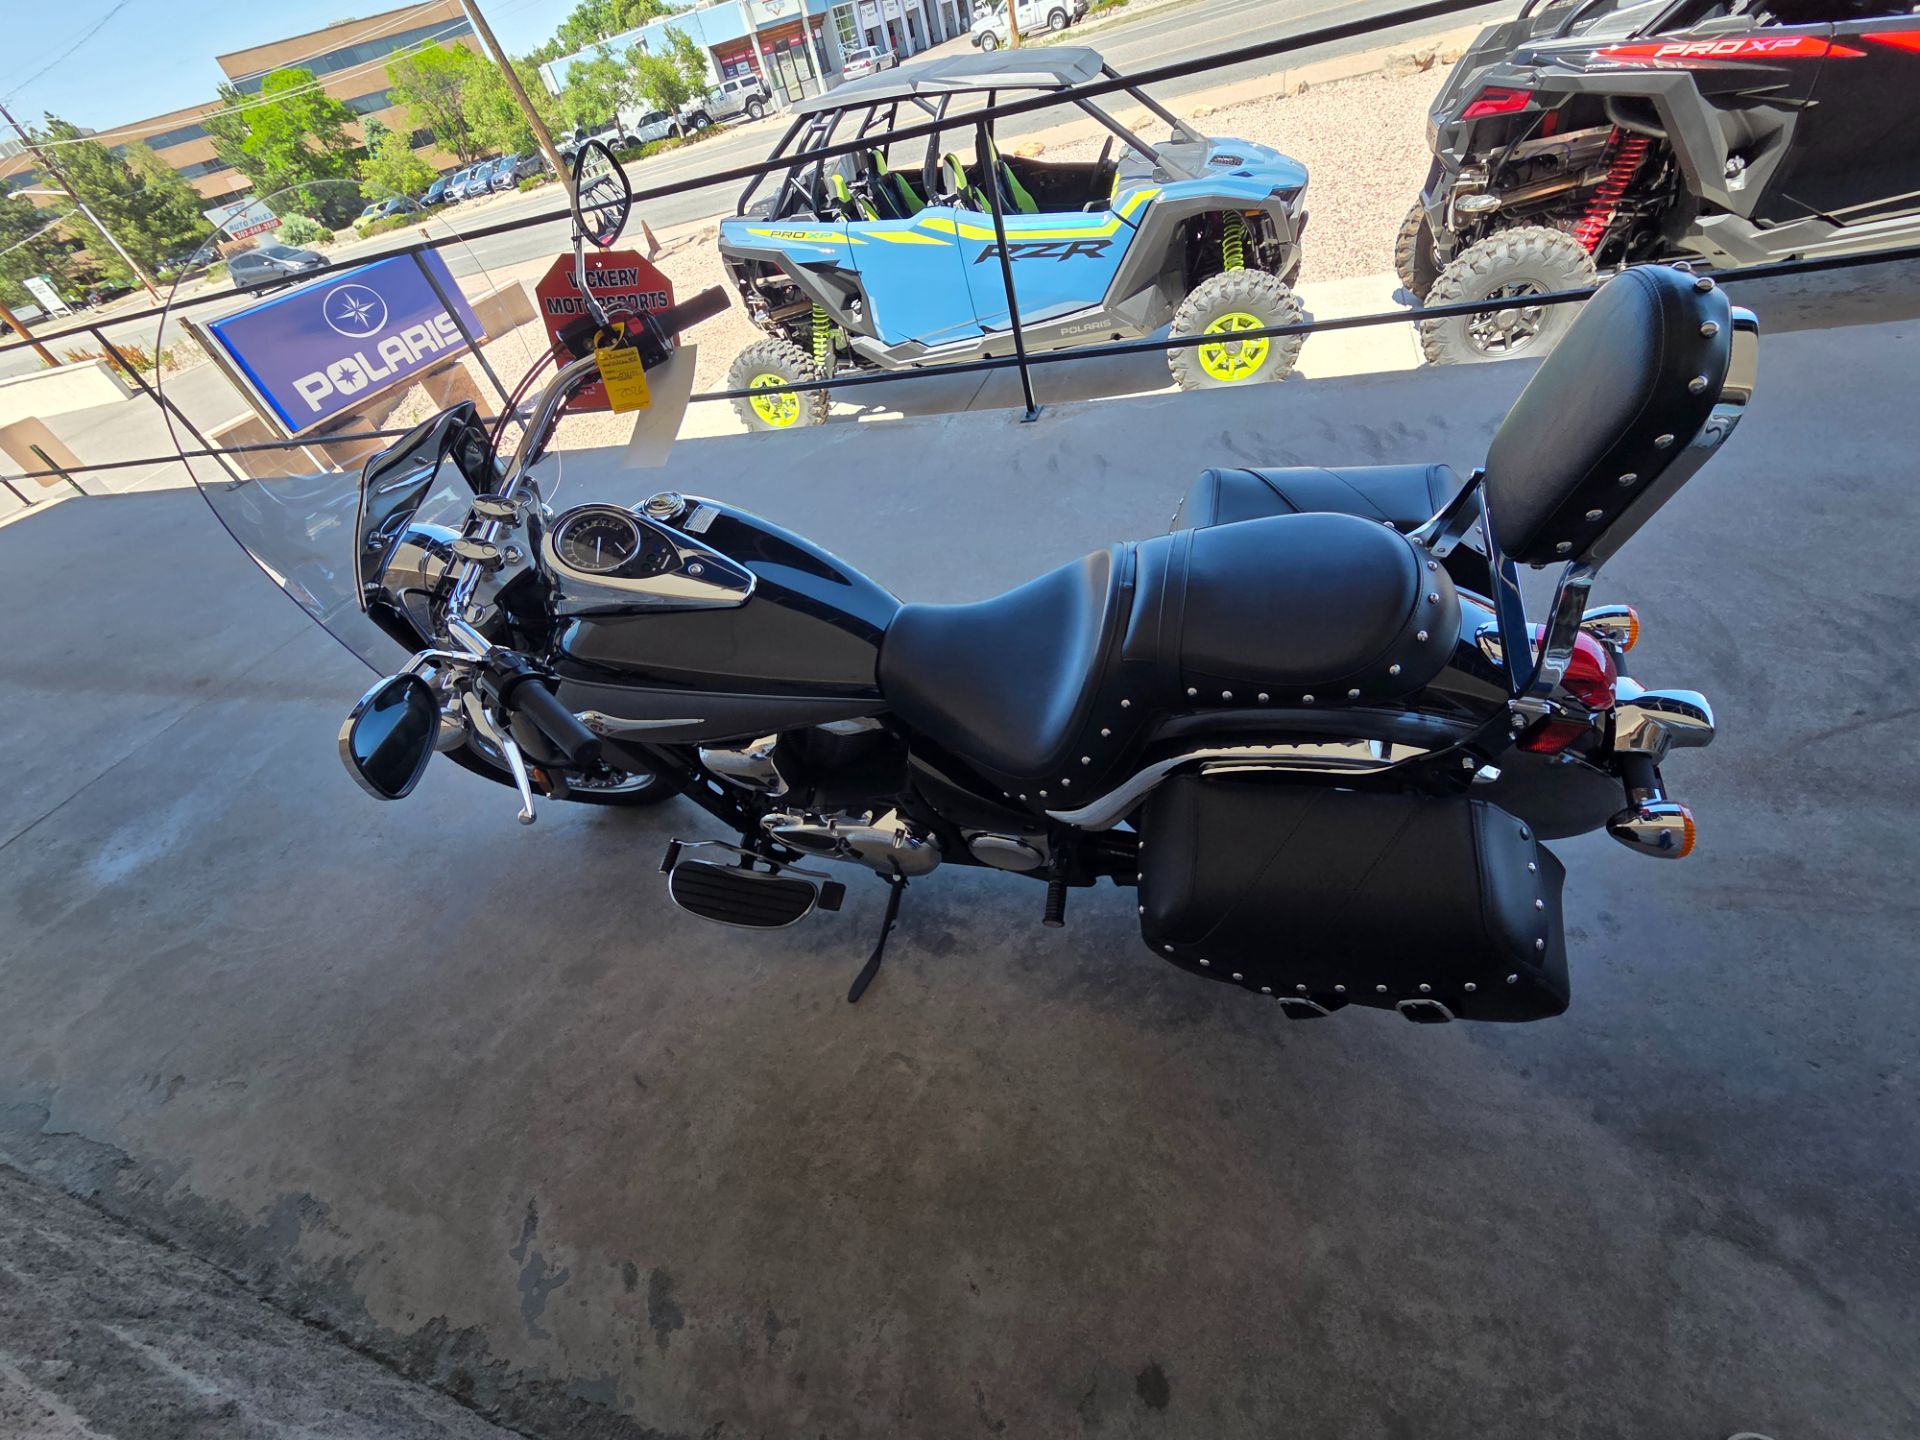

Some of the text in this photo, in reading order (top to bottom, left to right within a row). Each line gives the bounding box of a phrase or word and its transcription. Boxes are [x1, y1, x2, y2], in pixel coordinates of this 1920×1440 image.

[1655, 38, 1804, 57] PRO XP
[228, 212, 274, 232] AUTO SALES
[771, 230, 833, 239] PRO XP
[973, 240, 1114, 264] RZR
[566, 268, 639, 289] VCKERY
[546, 291, 667, 314] MOTRSPORTS
[1060, 319, 1111, 336] POLARIS
[292, 308, 464, 412] POLARIS
